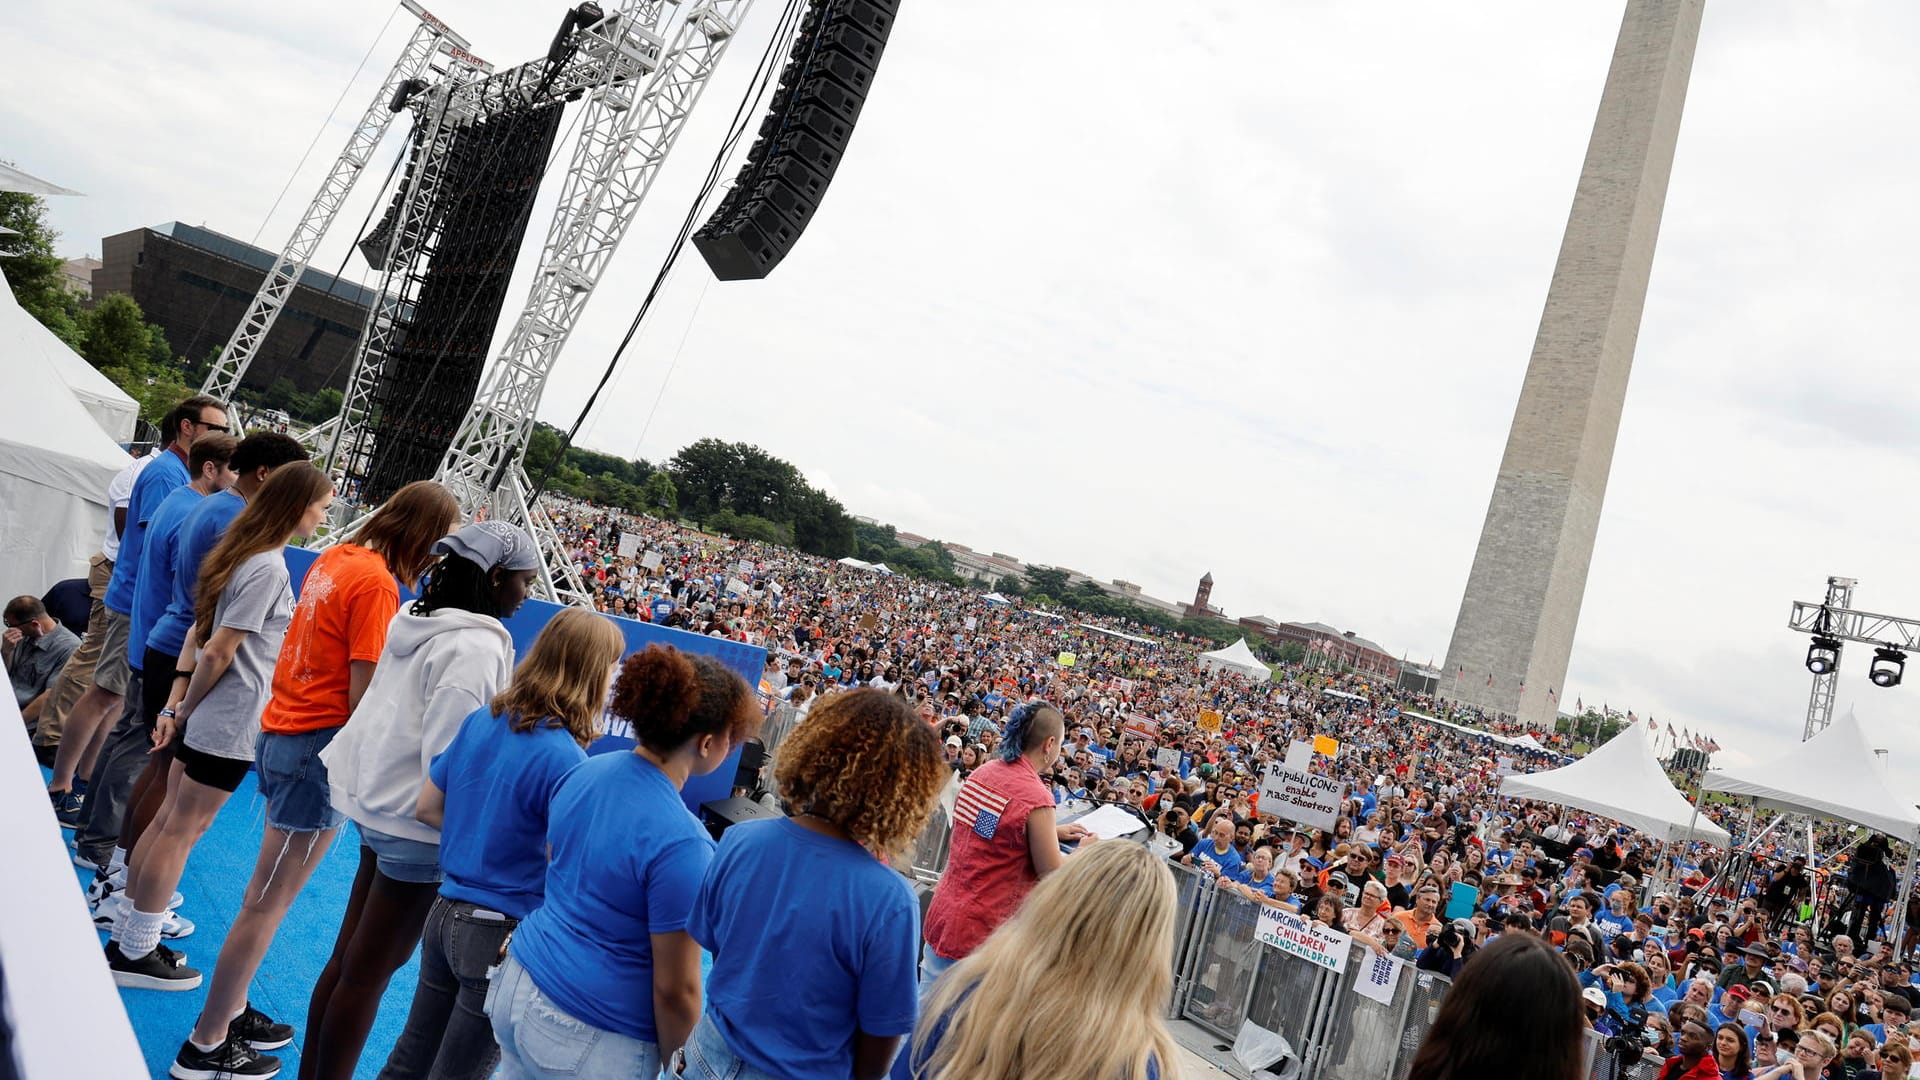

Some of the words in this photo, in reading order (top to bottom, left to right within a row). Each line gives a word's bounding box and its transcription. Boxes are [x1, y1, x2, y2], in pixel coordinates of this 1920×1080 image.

[422, 11, 449, 33] APPLIED
[450, 47, 484, 67] APPLIED
[1265, 789, 1290, 802] mass
[1290, 796, 1334, 814] shooters
[1260, 906, 1308, 933] MARCHING
[1323, 935, 1342, 945] our
[1262, 932, 1337, 968] GRANDCHILDREN
[1276, 926, 1327, 953] CHILDREN
[1376, 970, 1385, 986] OUR
[1383, 959, 1394, 985] MARCH
